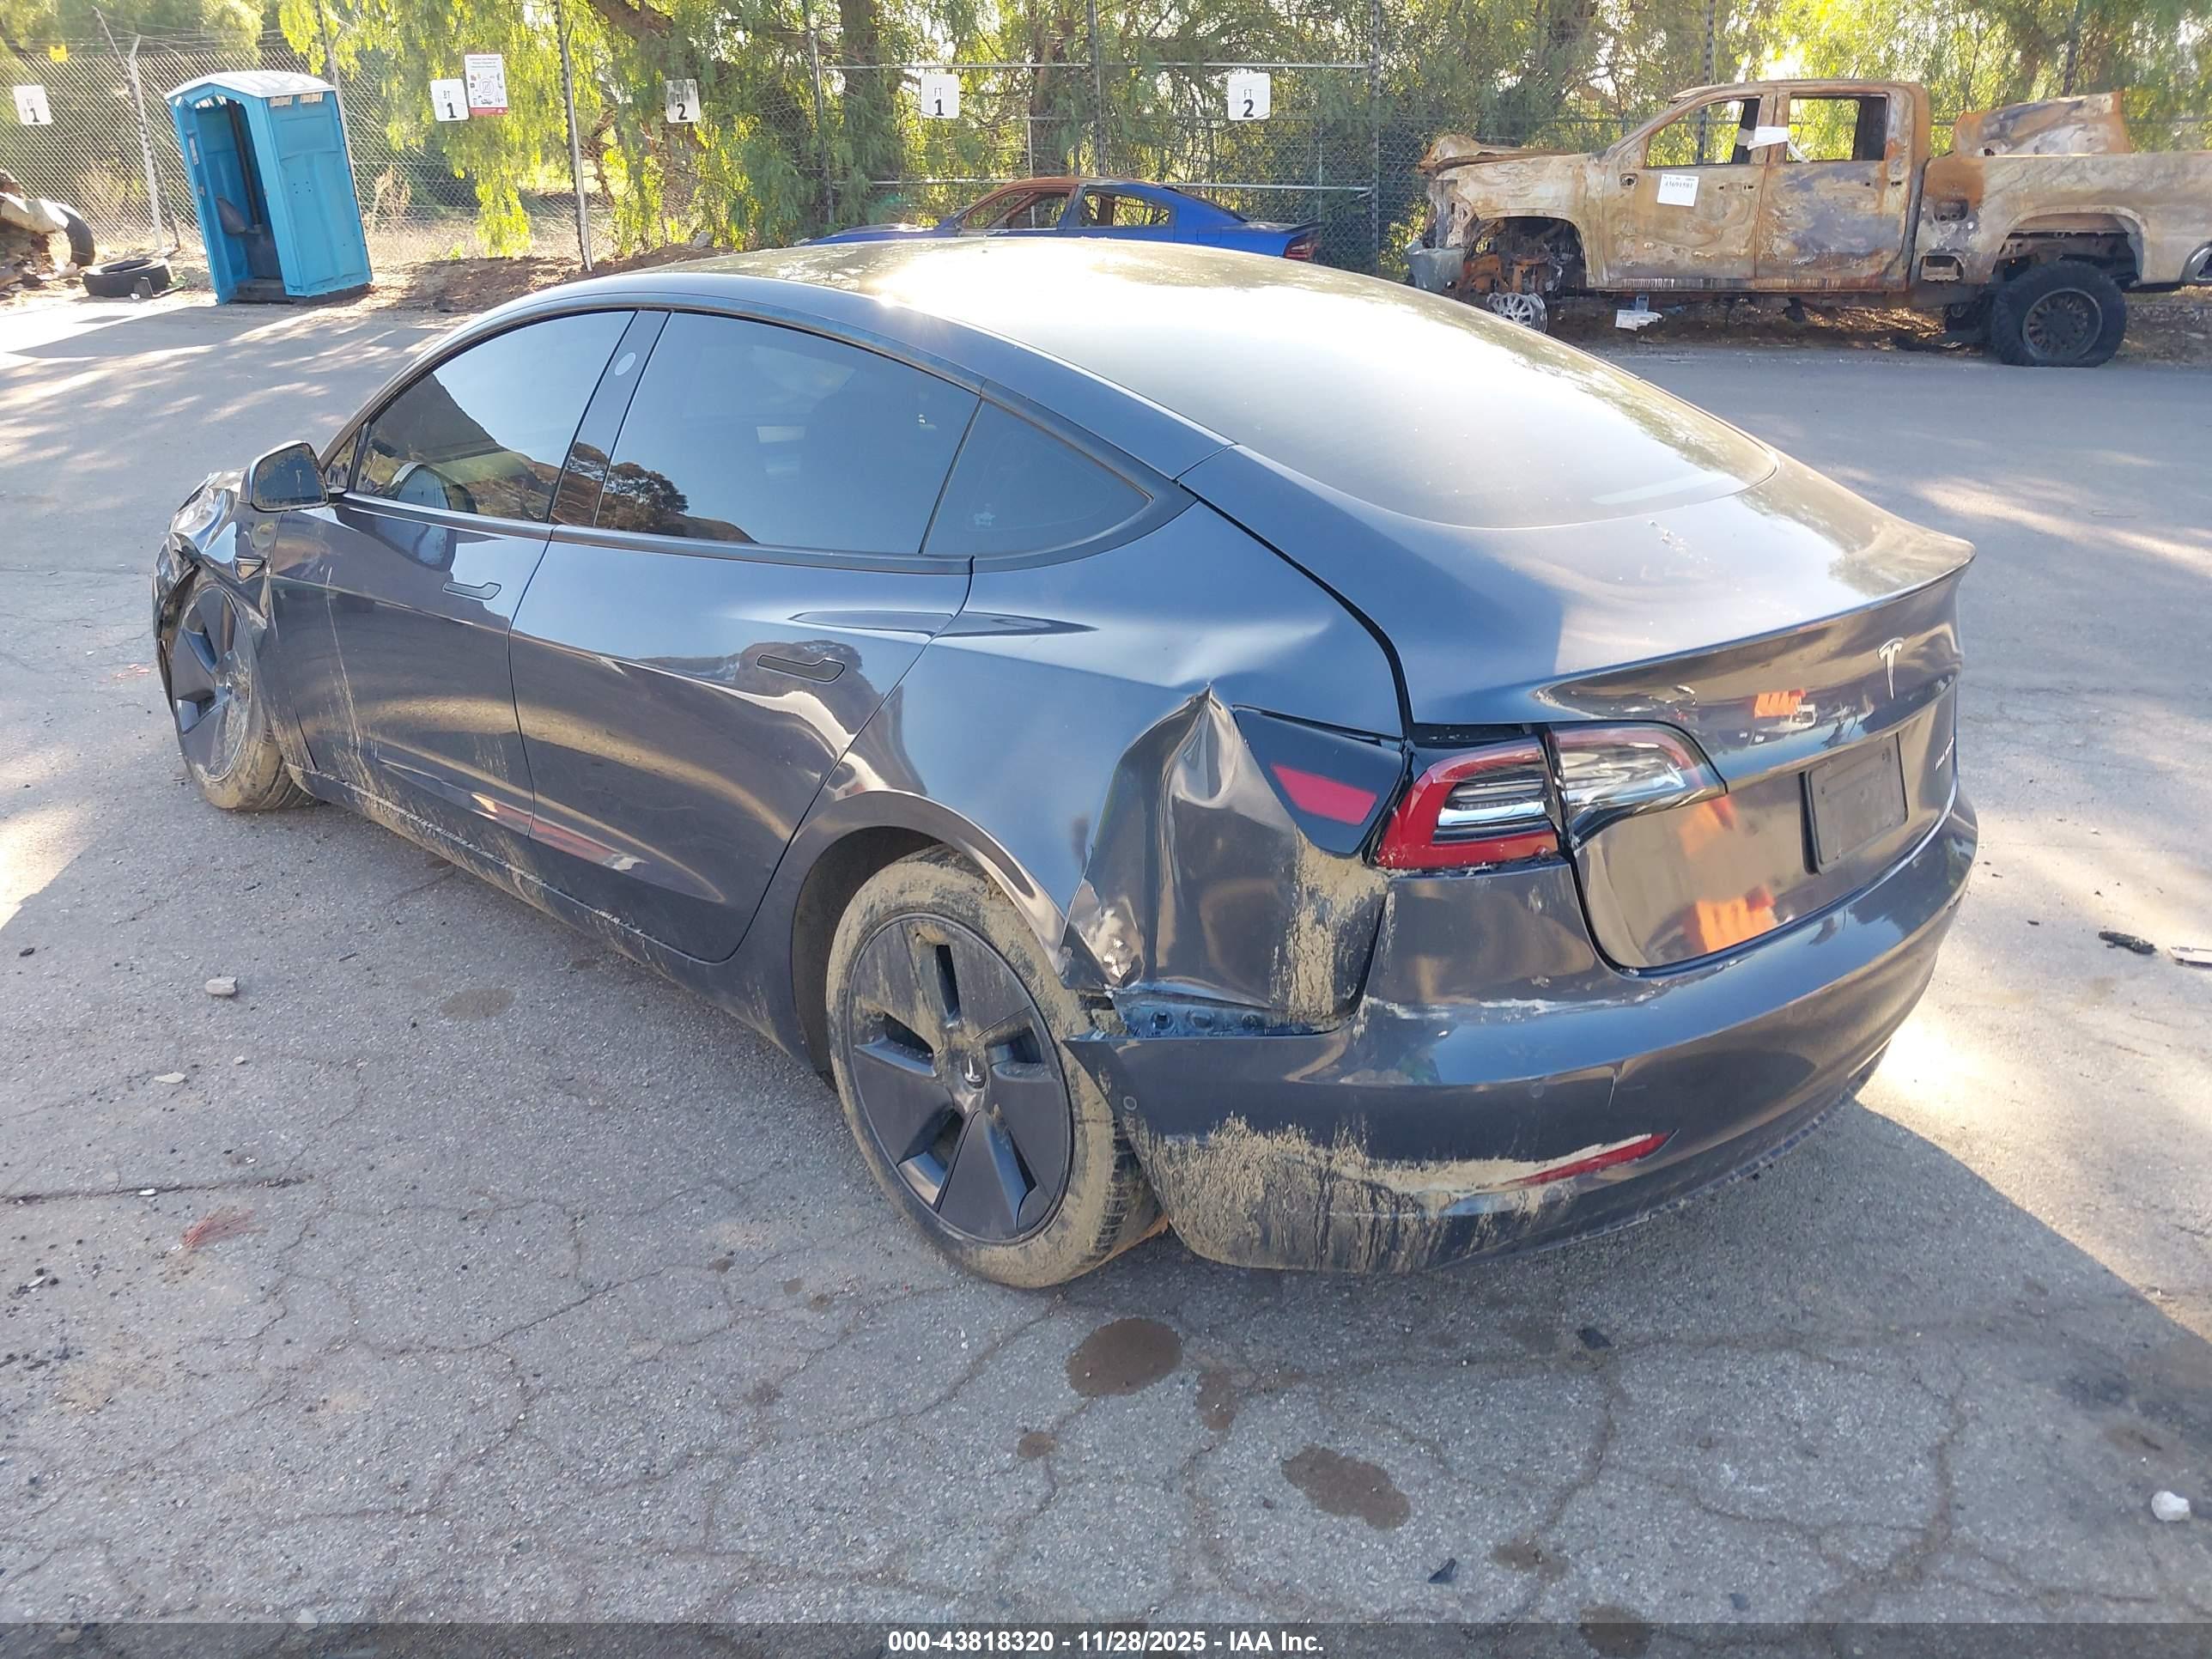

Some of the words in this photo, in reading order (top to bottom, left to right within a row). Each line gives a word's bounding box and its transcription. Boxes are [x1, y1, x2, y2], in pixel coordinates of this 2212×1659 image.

[1243, 88, 1254, 99] FT
[29, 107, 40, 123] 1
[447, 101, 458, 118] 1
[677, 102, 688, 120] 2
[934, 98, 945, 117] 1
[1243, 99, 1255, 118] 2
